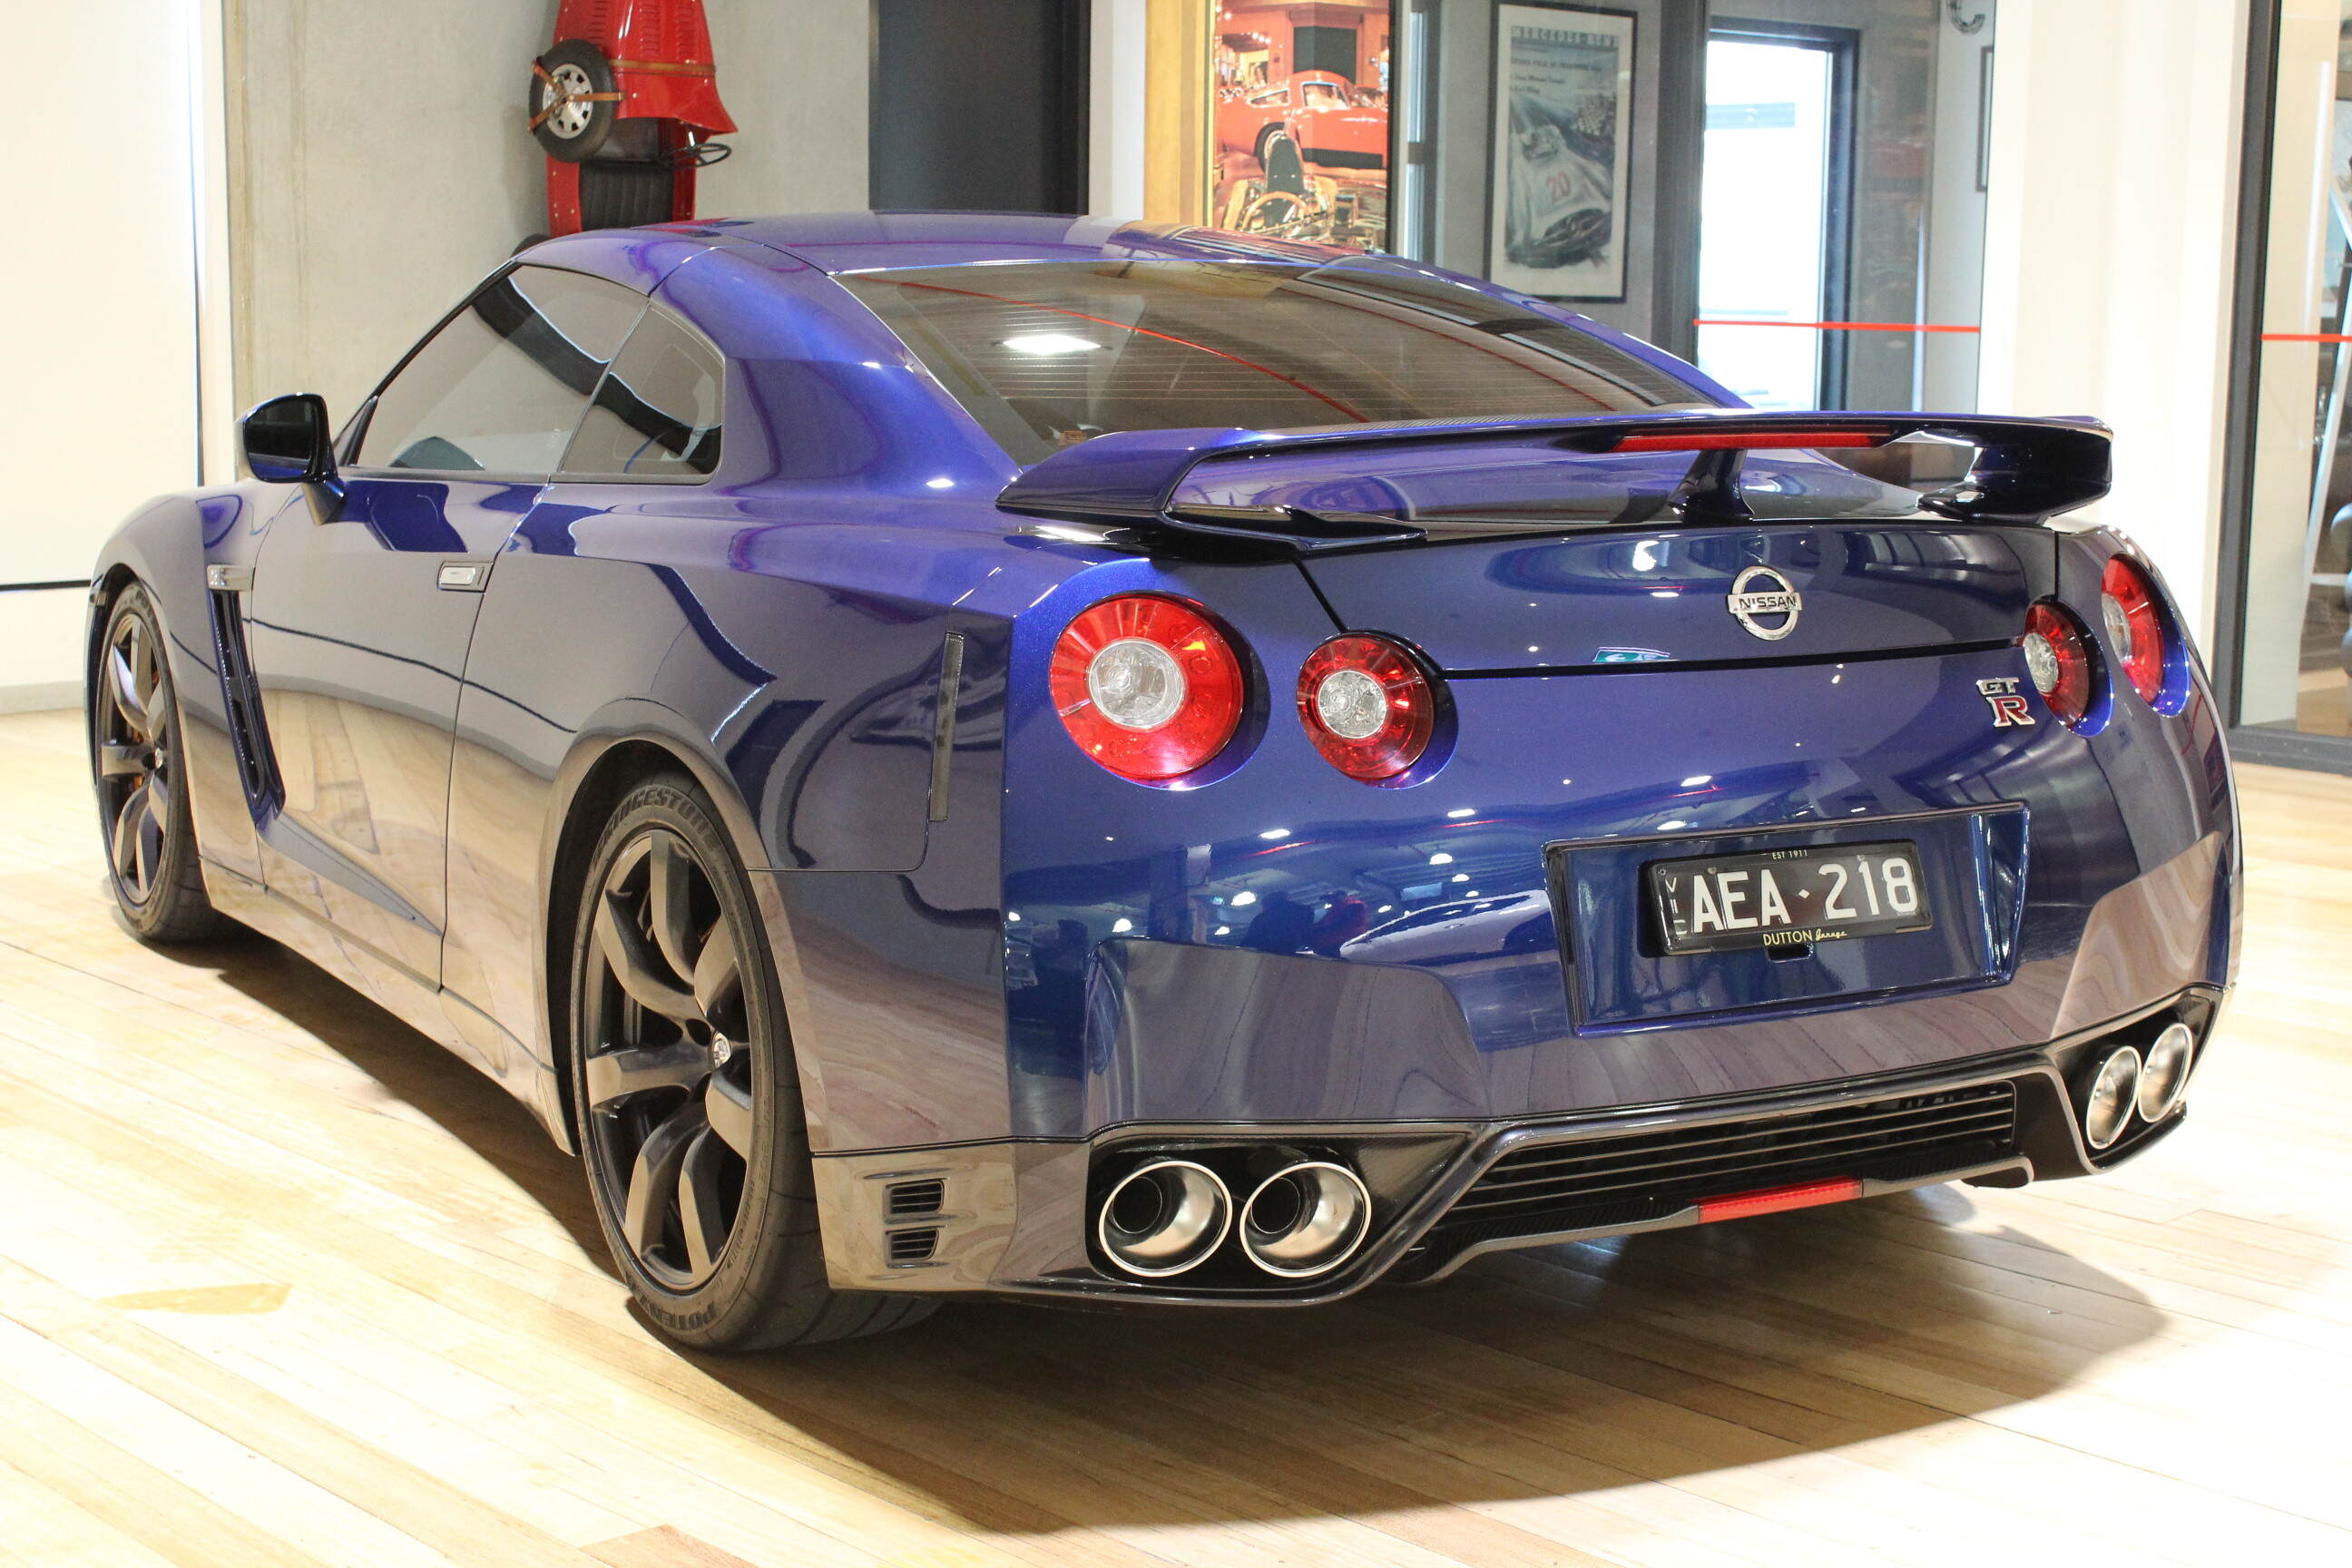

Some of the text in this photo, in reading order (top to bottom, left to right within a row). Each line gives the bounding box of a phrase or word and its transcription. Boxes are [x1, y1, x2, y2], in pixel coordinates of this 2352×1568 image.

[1738, 595, 1797, 609] NISSAN
[1771, 849, 1808, 859] EST 1911
[1763, 929, 1813, 946] DUTTON
